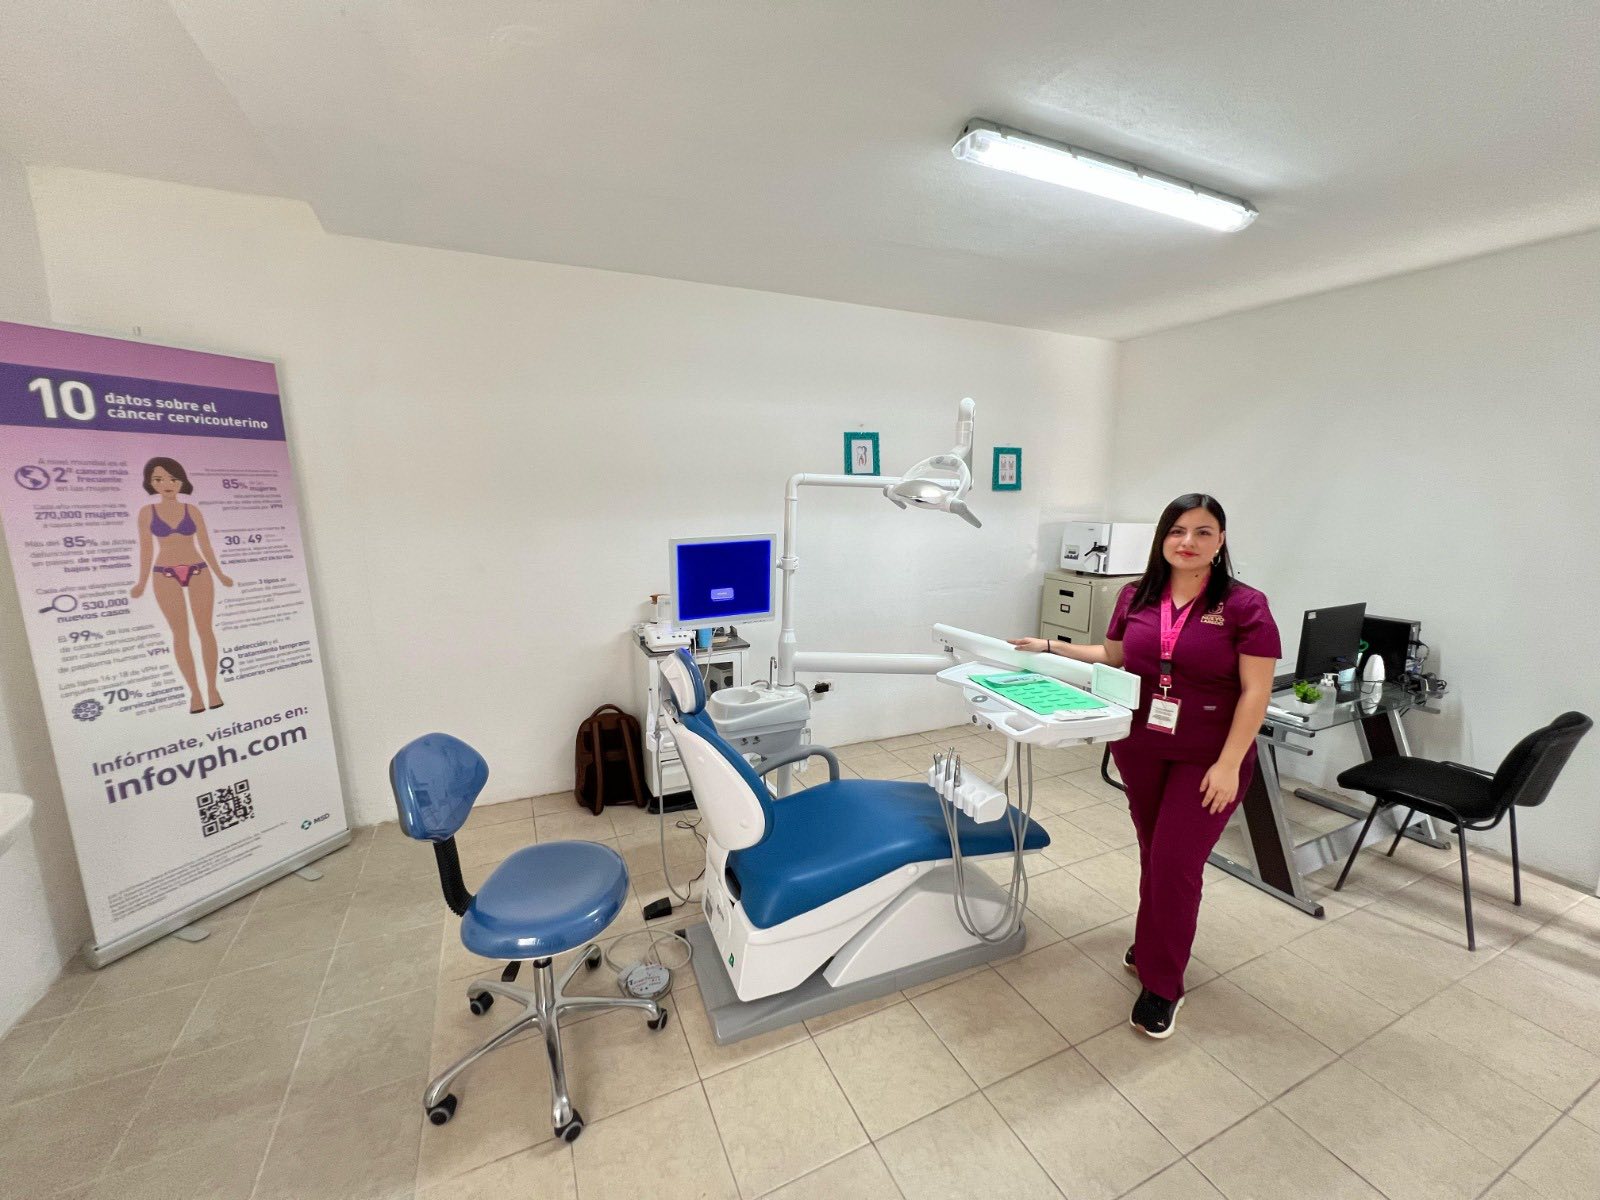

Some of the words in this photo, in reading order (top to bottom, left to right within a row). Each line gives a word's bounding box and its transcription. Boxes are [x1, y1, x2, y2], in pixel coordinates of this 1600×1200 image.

[28, 377, 96, 421] 10
[105, 393, 152, 407] datos
[156, 396, 199, 411] sobre
[202, 402, 217, 413] el
[107, 406, 164, 421] cáncer
[168, 412, 268, 429] cervicouterino
[85, 510, 129, 520] mujeres
[248, 534, 262, 543] 49
[82, 597, 129, 611] 530,000
[57, 612, 98, 624] nuevos
[101, 608, 131, 618] casos
[69, 629, 104, 643] 99%
[147, 646, 170, 657] VPH
[222, 646, 233, 654] La
[103, 688, 143, 705] 70%
[92, 736, 204, 777] Infórmate,
[206, 713, 282, 743] visítanos
[284, 705, 309, 719] en:
[104, 725, 308, 804] infovph.com
